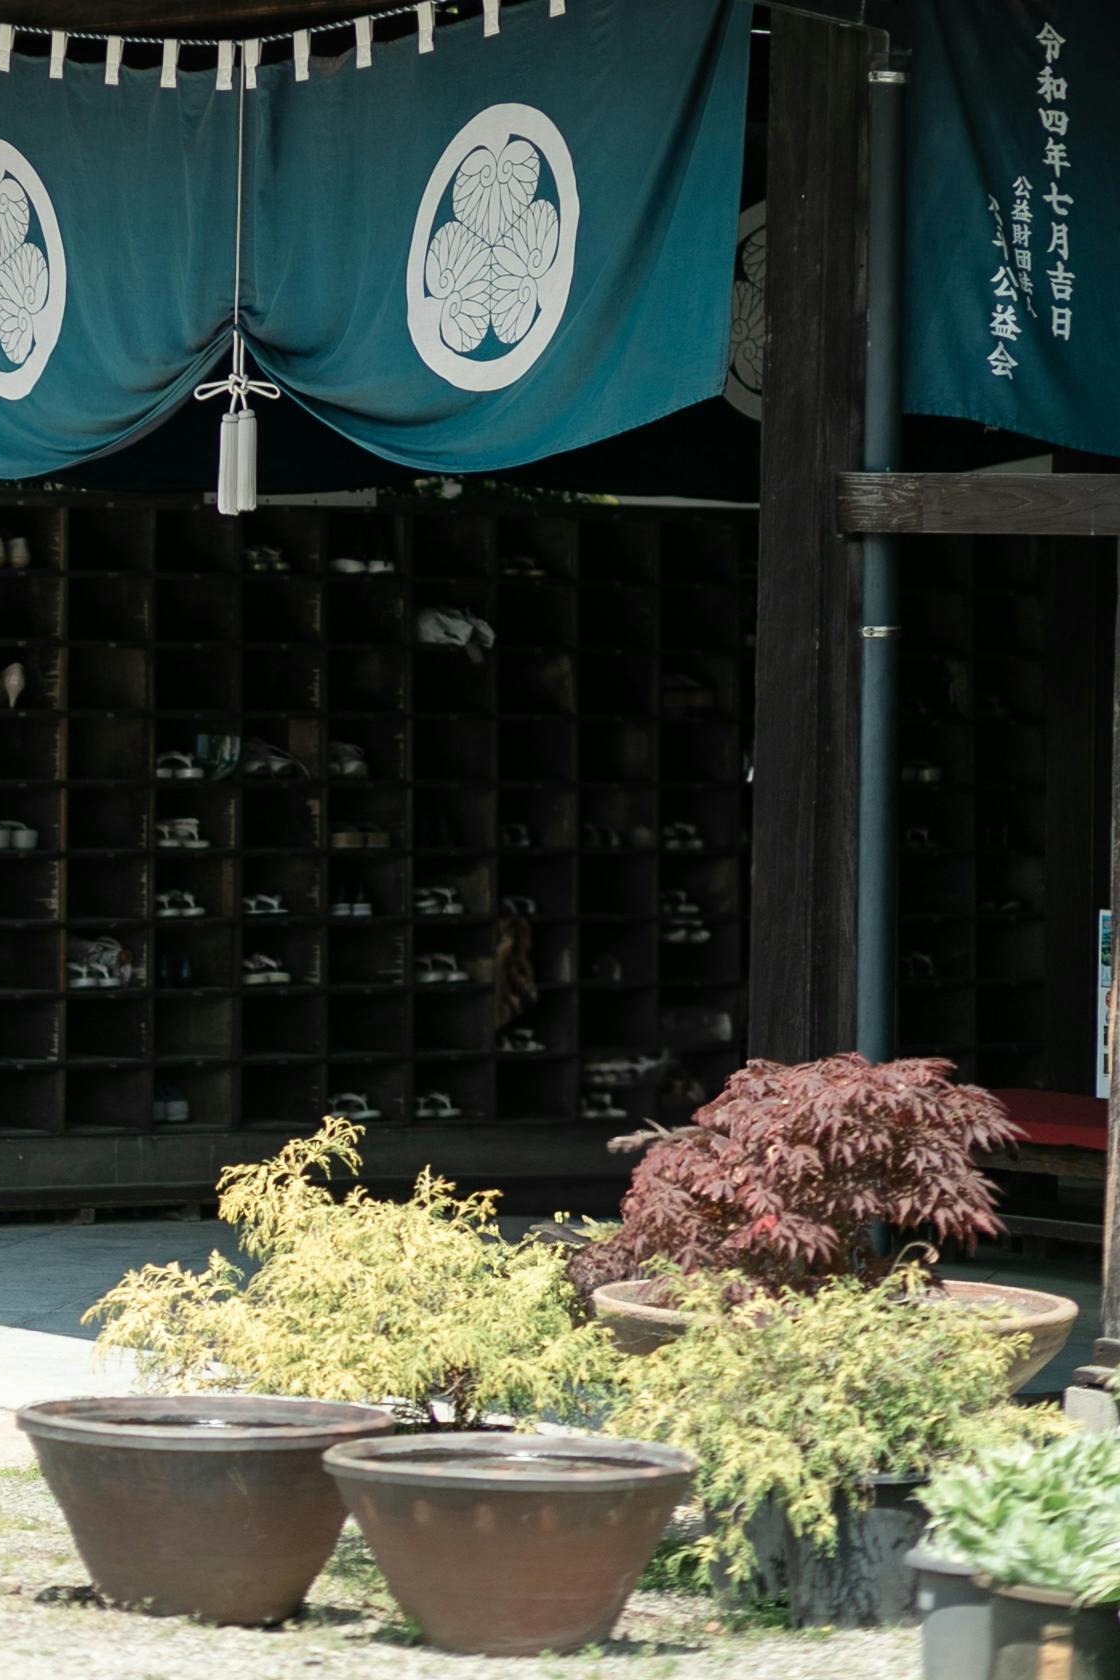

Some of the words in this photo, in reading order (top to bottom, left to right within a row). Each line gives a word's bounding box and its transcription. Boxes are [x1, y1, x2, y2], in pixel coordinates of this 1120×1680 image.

[1035, 22, 1076, 341] 令和四年七月吉日
